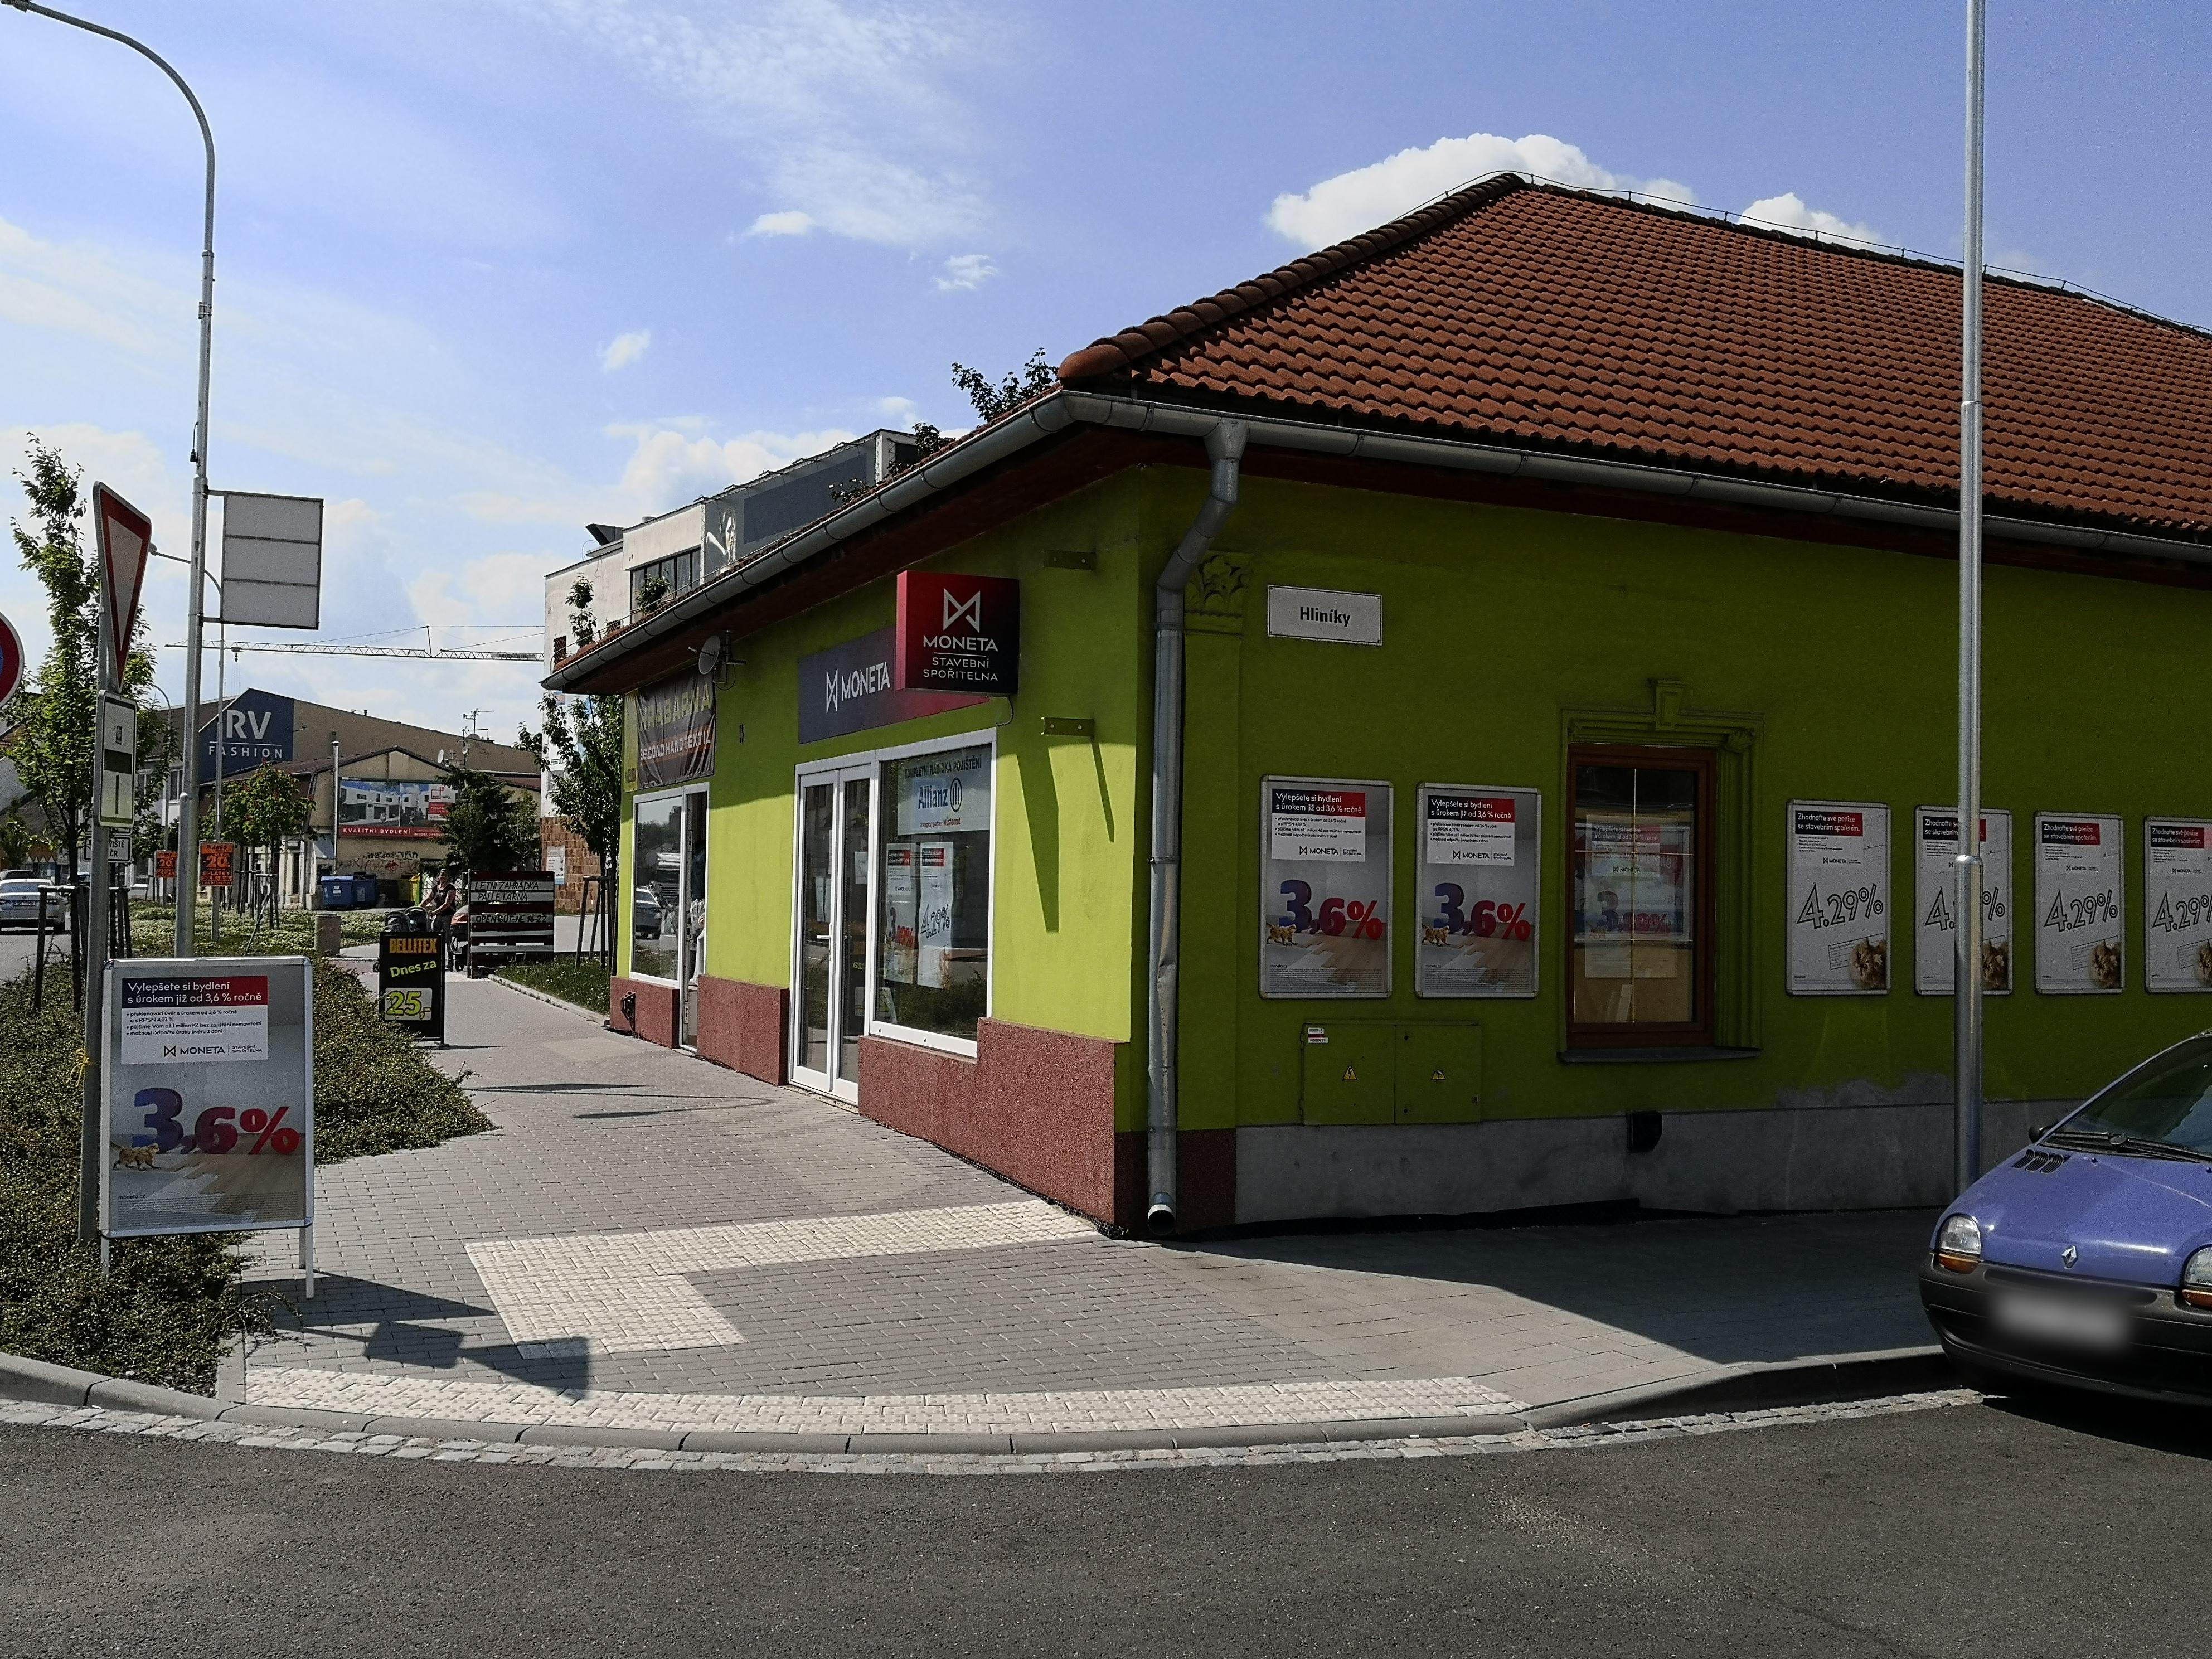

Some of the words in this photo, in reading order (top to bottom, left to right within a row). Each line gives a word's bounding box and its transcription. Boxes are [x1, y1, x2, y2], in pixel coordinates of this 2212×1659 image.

[1300, 607, 1351, 627] Hliníky
[923, 635, 998, 652] MONETA
[932, 657, 989, 668] STAVEBNÍ
[841, 662, 890, 701] MONETA
[923, 668, 998, 681] SPOŘITELNA
[226, 710, 271, 740] RV
[640, 744, 664, 761] SECOND
[666, 737, 683, 755] HAND
[685, 730, 711, 749] TEXTIL
[953, 755, 982, 772] POJIŠTĚNÍ
[918, 785, 948, 809] Allianz
[1276, 793, 1310, 802] Vylepšete
[1318, 795, 1342, 803] bydlení
[1431, 799, 1462, 808] Vylepšete
[1326, 804, 1335, 813] 3,6
[1478, 811, 1486, 819] 3,6
[1279, 880, 1384, 940] 3,6%
[1433, 882, 1531, 942] 3,6%
[1797, 883, 1883, 929] 4.29%
[2044, 889, 2118, 932] 4.29%
[390, 938, 437, 953] BELLITEX
[390, 964, 421, 977] Dnes
[423, 961, 436, 970] za
[128, 983, 180, 993] Vylepšete
[193, 982, 230, 992] bydlení
[136, 994, 173, 1003] úrokem
[177, 995, 187, 1005] již
[205, 994, 219, 1003] 3,6
[222, 993, 231, 1001] %
[234, 992, 261, 1001] ročně
[180, 1046, 225, 1055] MONETA
[132, 1088, 301, 1155] 3,6%
